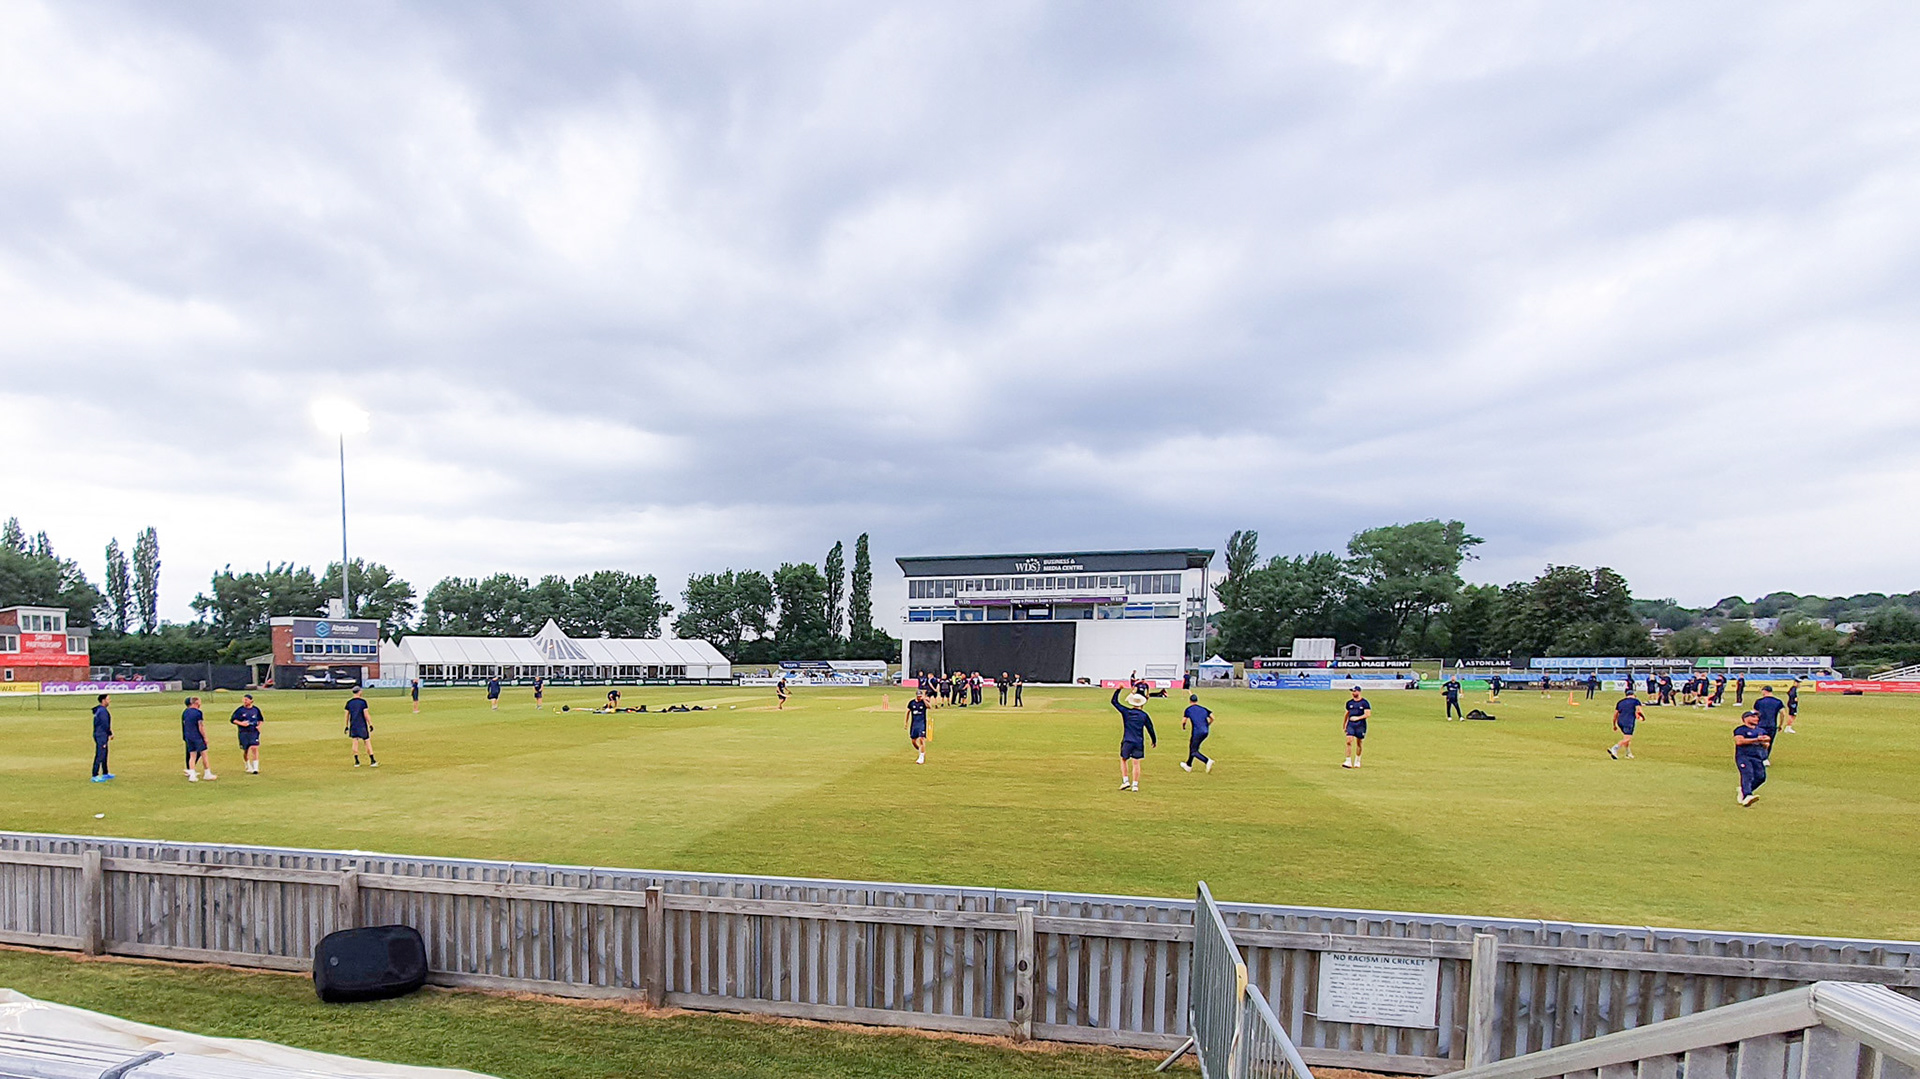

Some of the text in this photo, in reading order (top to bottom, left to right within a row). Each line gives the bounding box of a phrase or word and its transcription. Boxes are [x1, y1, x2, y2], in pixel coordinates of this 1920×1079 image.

[1015, 562, 1037, 572] WDS
[1535, 659, 1604, 667] OFFICECARE
[1348, 955, 1379, 963] RACISM
[1392, 957, 1425, 966] CRICKET
